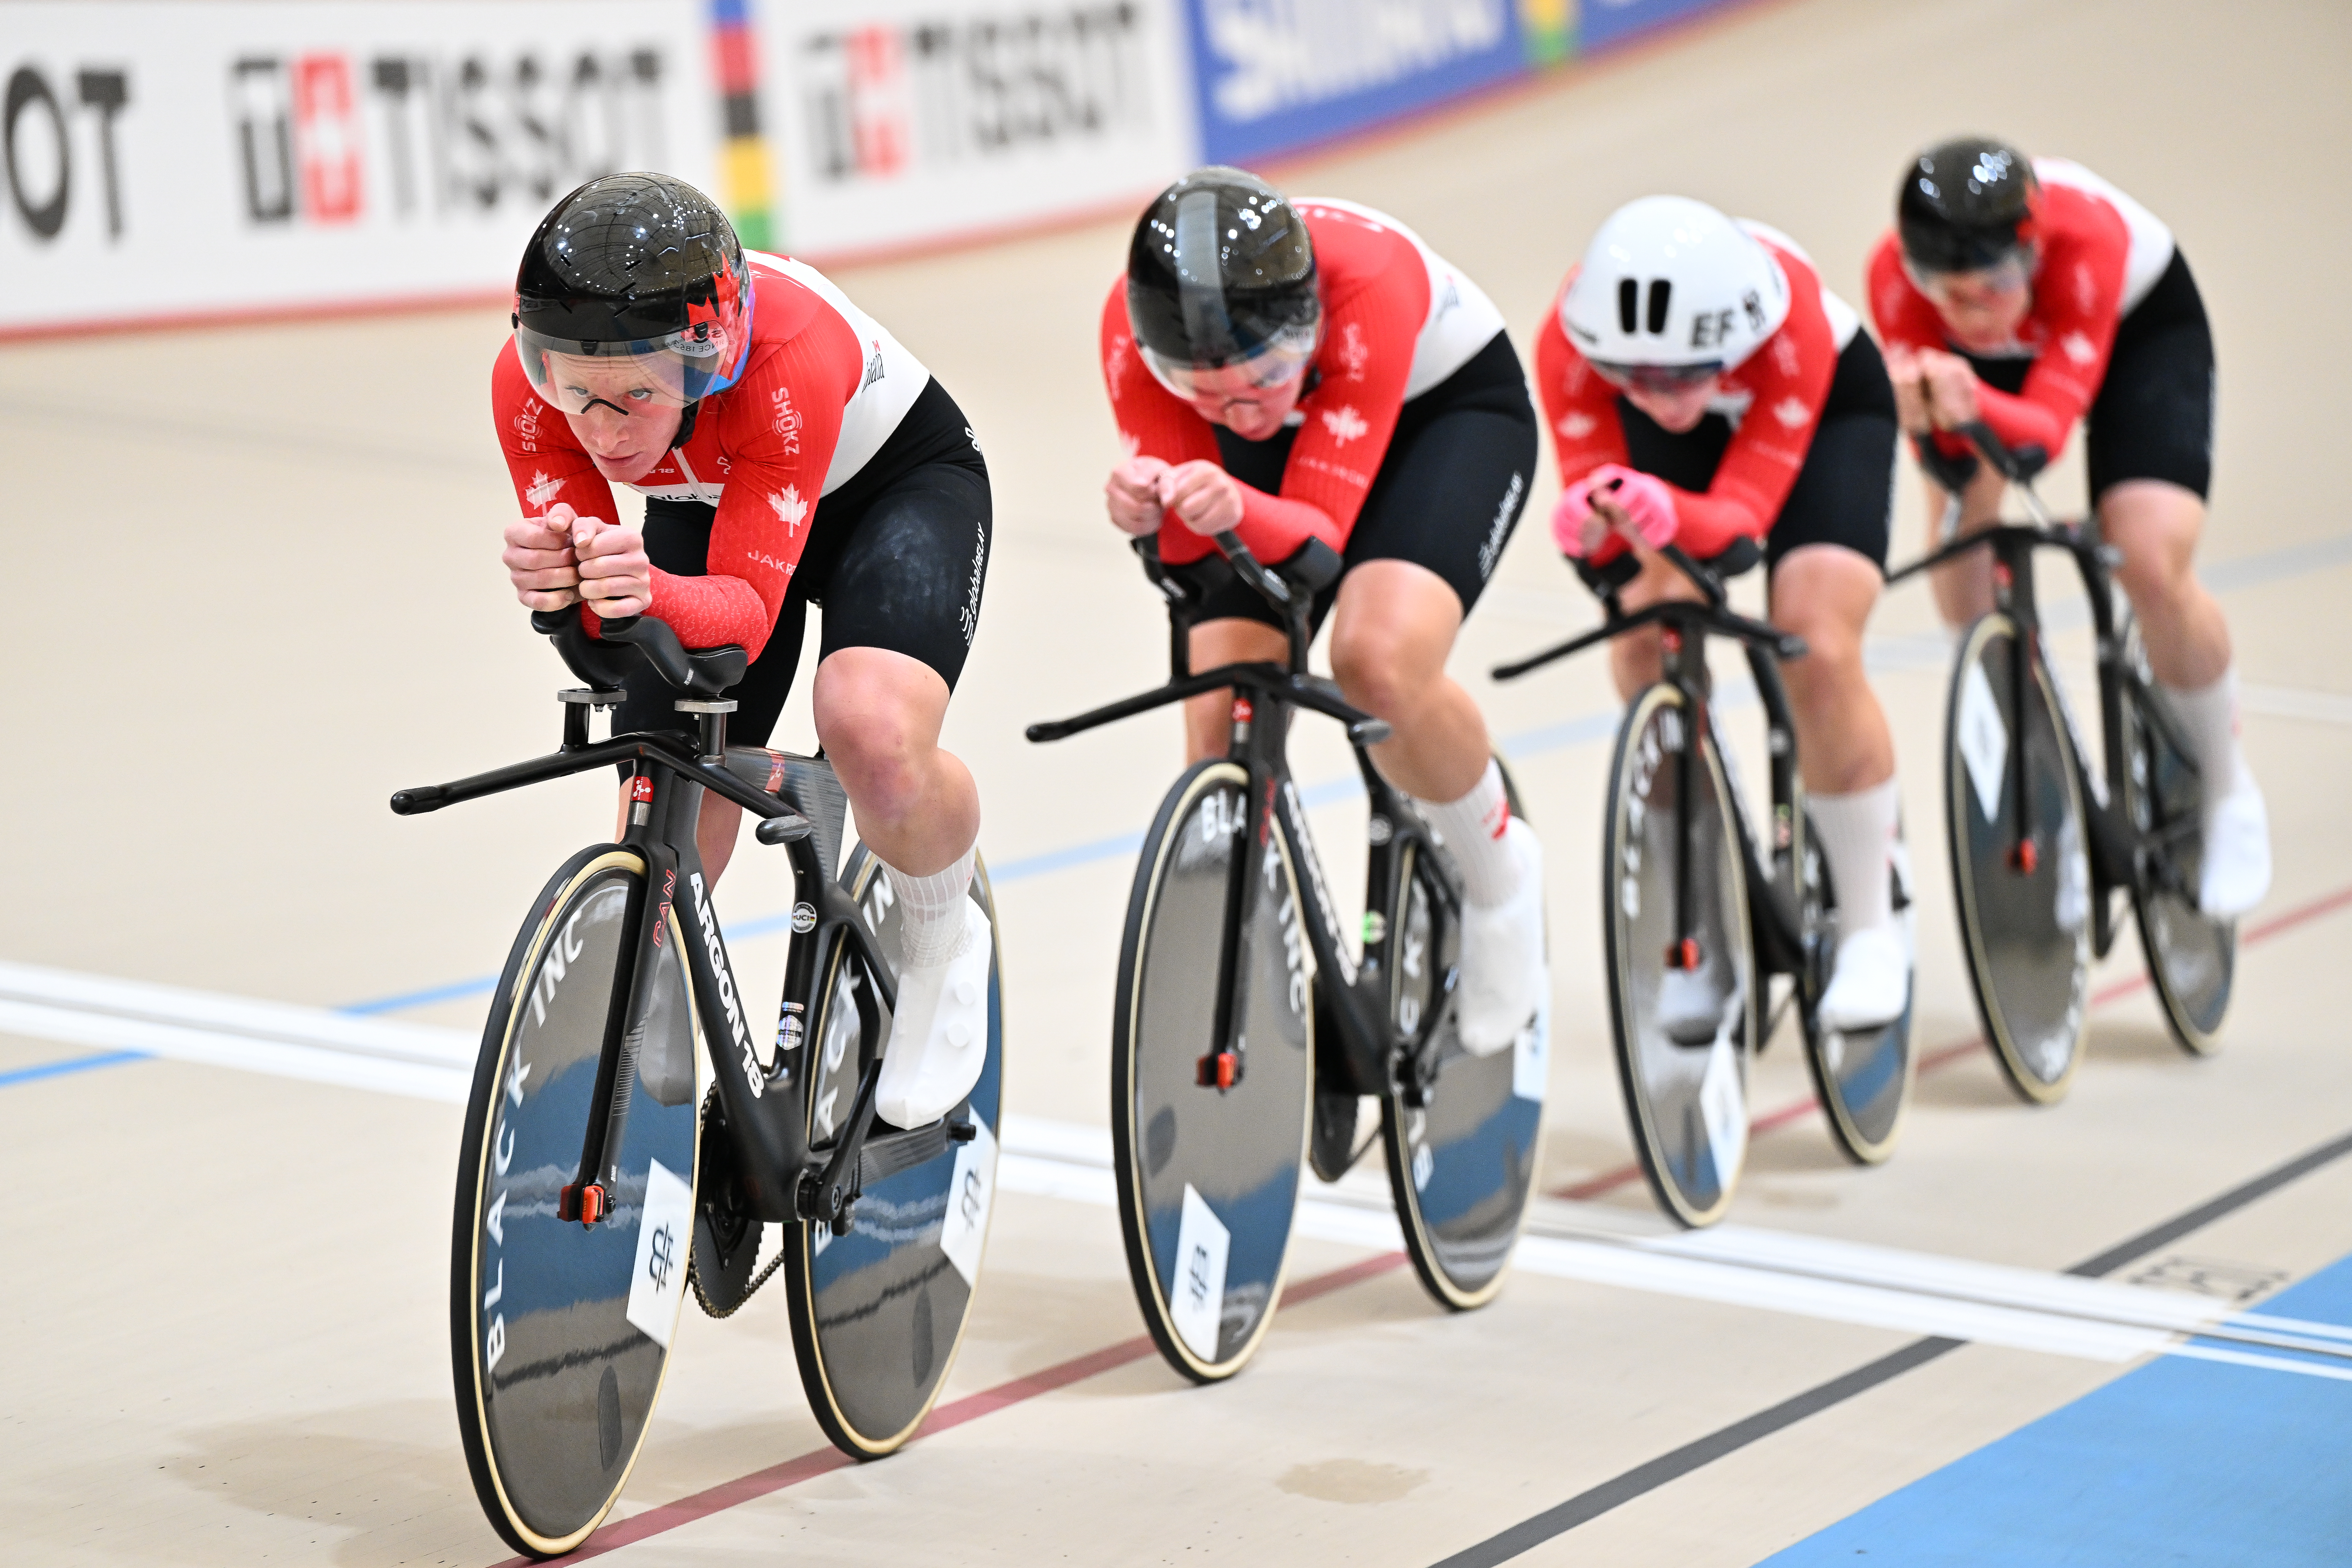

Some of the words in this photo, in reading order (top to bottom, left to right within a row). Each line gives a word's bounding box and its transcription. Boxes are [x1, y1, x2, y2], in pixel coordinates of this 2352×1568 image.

[1689, 308, 1735, 348] EF
[772, 387, 800, 455] SHOKZ
[653, 869, 677, 947] CAN
[690, 871, 745, 1048] ARGON
[742, 1040, 765, 1099] 18
[484, 1043, 531, 1373] BLACK
[529, 908, 584, 1028] INC
